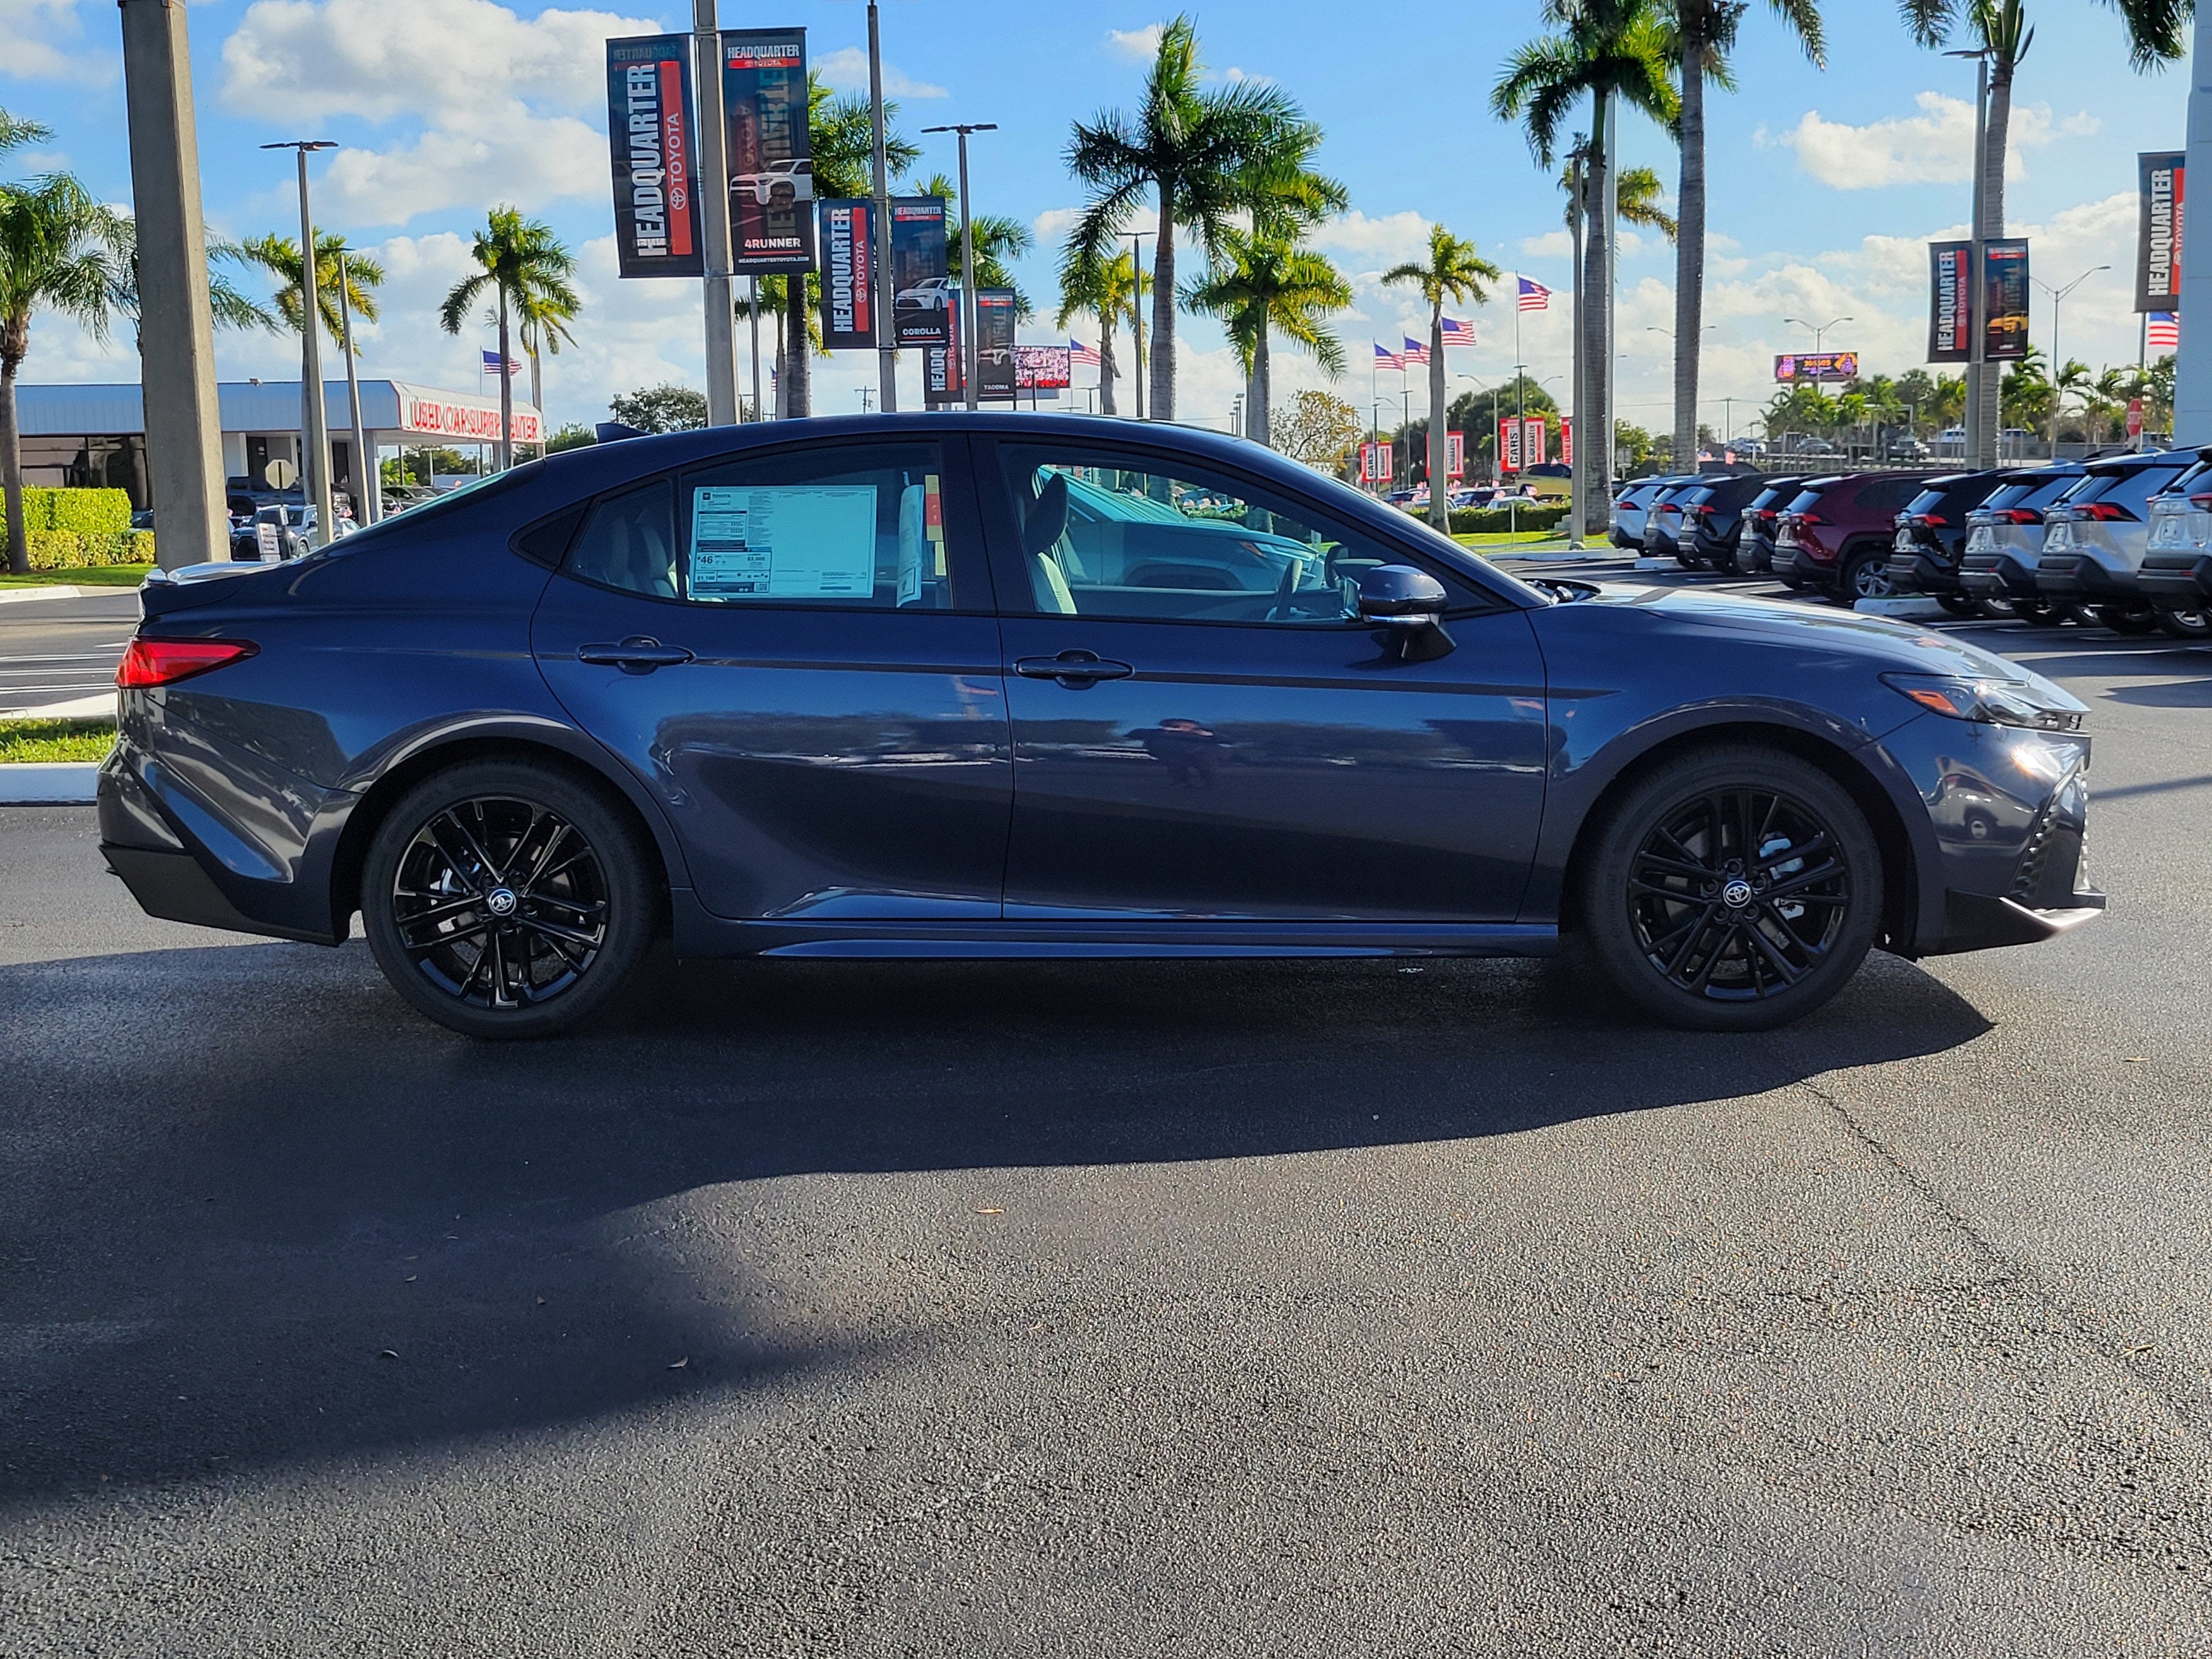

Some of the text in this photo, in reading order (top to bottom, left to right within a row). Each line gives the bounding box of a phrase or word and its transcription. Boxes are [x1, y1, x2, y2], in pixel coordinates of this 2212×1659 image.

[727, 44, 800, 60] HEADQUARTER
[627, 63, 667, 256] HEADQUARTER
[667, 113, 683, 185] TOYOTA
[744, 238, 801, 249] 4RUNNER
[2148, 168, 2172, 296] HEADQUARTER
[831, 208, 854, 332] HEADQUARTER
[856, 240, 865, 286] TOYOTA
[1937, 251, 1956, 351] HEADQUARTER
[1958, 276, 1967, 314] TOYOTA
[413, 402, 442, 430] USED
[444, 406, 466, 435] CAR
[469, 410, 500, 436] SUPER
[1510, 432, 1519, 464] CARS
[701, 556, 713, 564] 46
